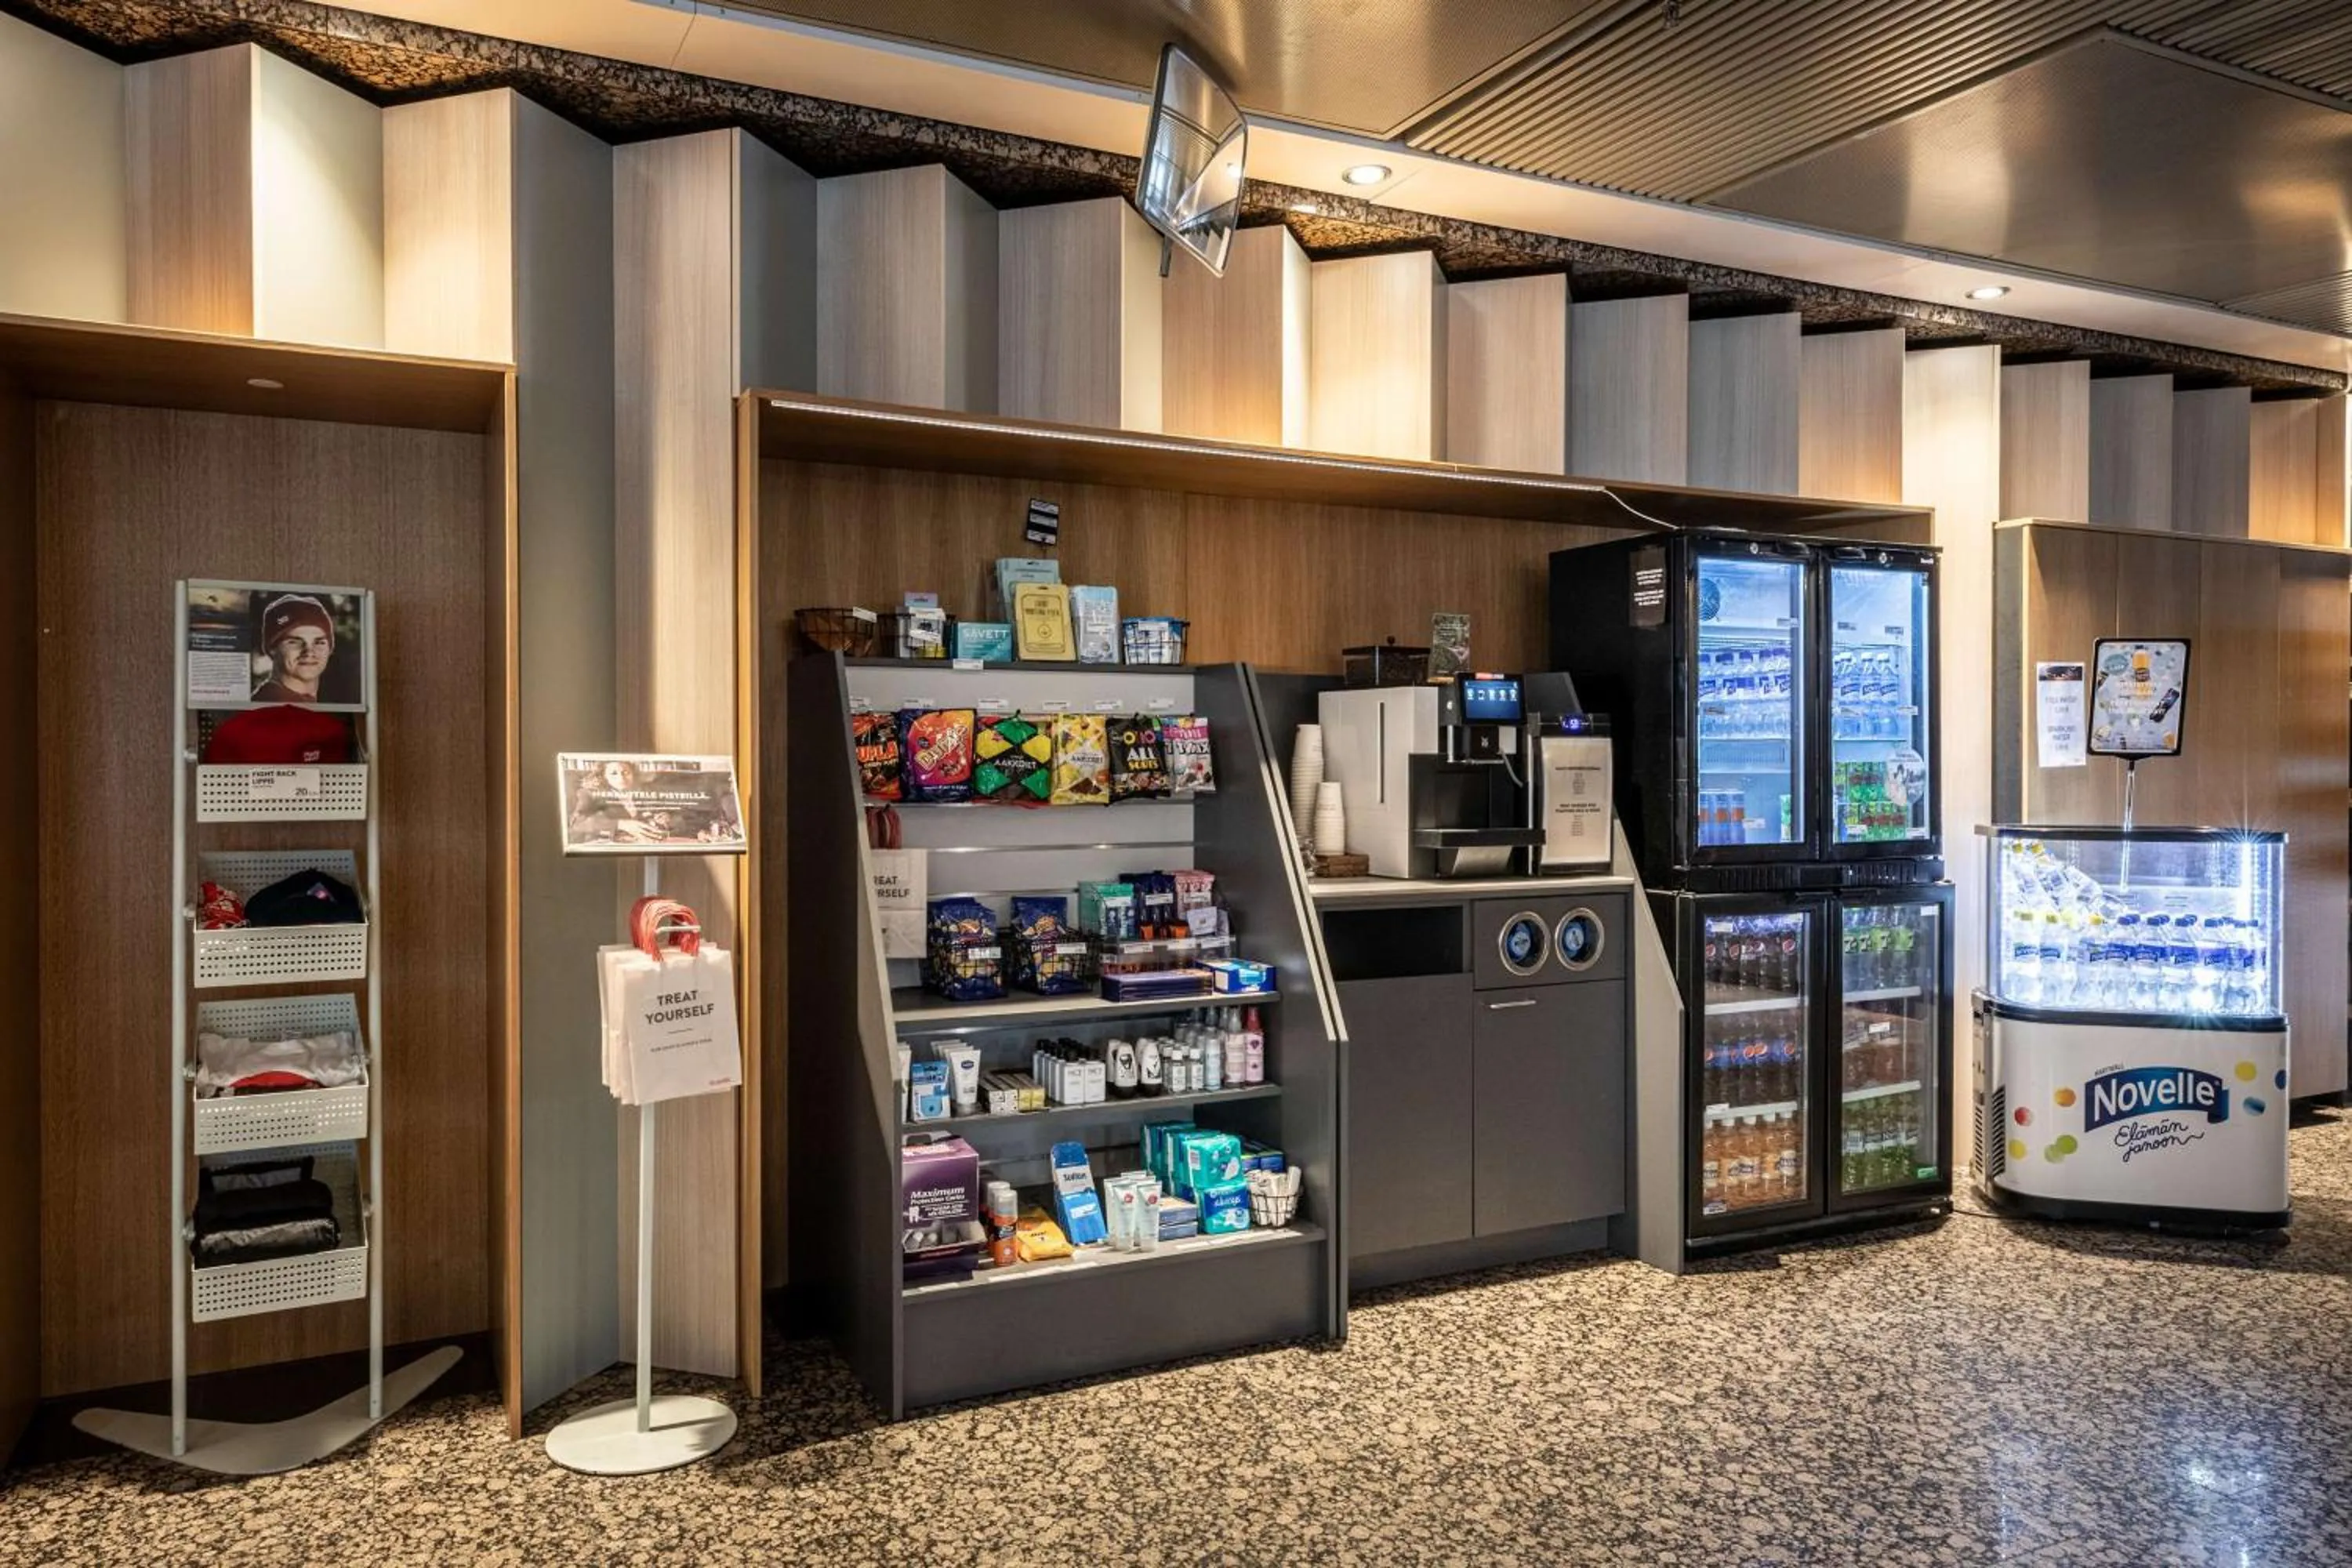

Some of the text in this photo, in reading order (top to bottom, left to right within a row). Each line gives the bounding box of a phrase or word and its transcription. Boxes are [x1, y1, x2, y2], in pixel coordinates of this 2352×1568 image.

[657, 989, 699, 1006] TREAT
[644, 1003, 714, 1024] YOURSELF
[2094, 1072, 2215, 1122] Novelle
[2114, 1119, 2188, 1146] Elämän
[2122, 1131, 2205, 1163] janoon
[910, 1185, 965, 1200] Maximum
